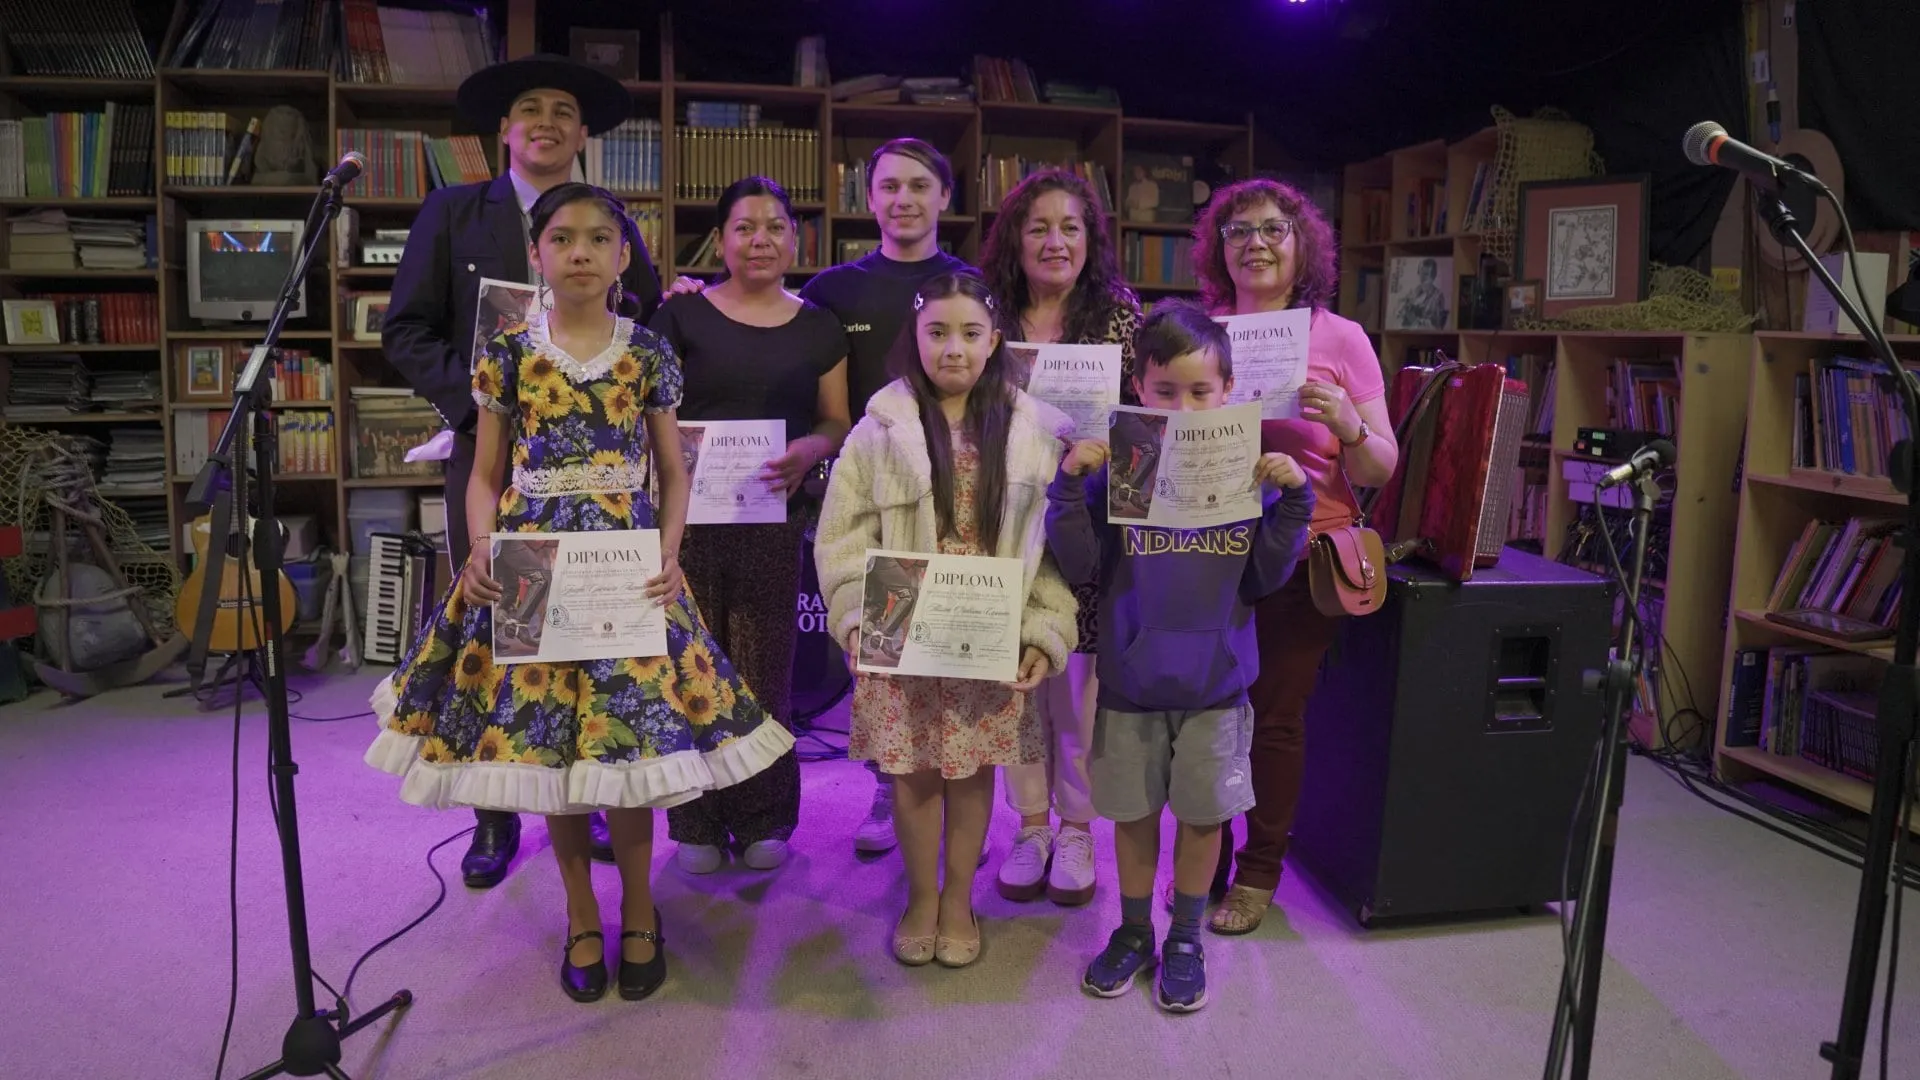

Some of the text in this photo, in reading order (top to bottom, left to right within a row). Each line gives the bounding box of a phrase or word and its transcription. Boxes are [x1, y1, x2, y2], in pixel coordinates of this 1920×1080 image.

[843, 323, 871, 332] arlos
[1233, 326, 1293, 341] DIPLOMA
[1043, 359, 1105, 371] DIPLOMA
[1175, 423, 1245, 442] DIPLOMA
[711, 435, 770, 447] DIPLOMA
[1122, 525, 1250, 556] NDIANS
[567, 549, 642, 564] DIPLOMA
[934, 572, 1004, 588] DIPLOMA
